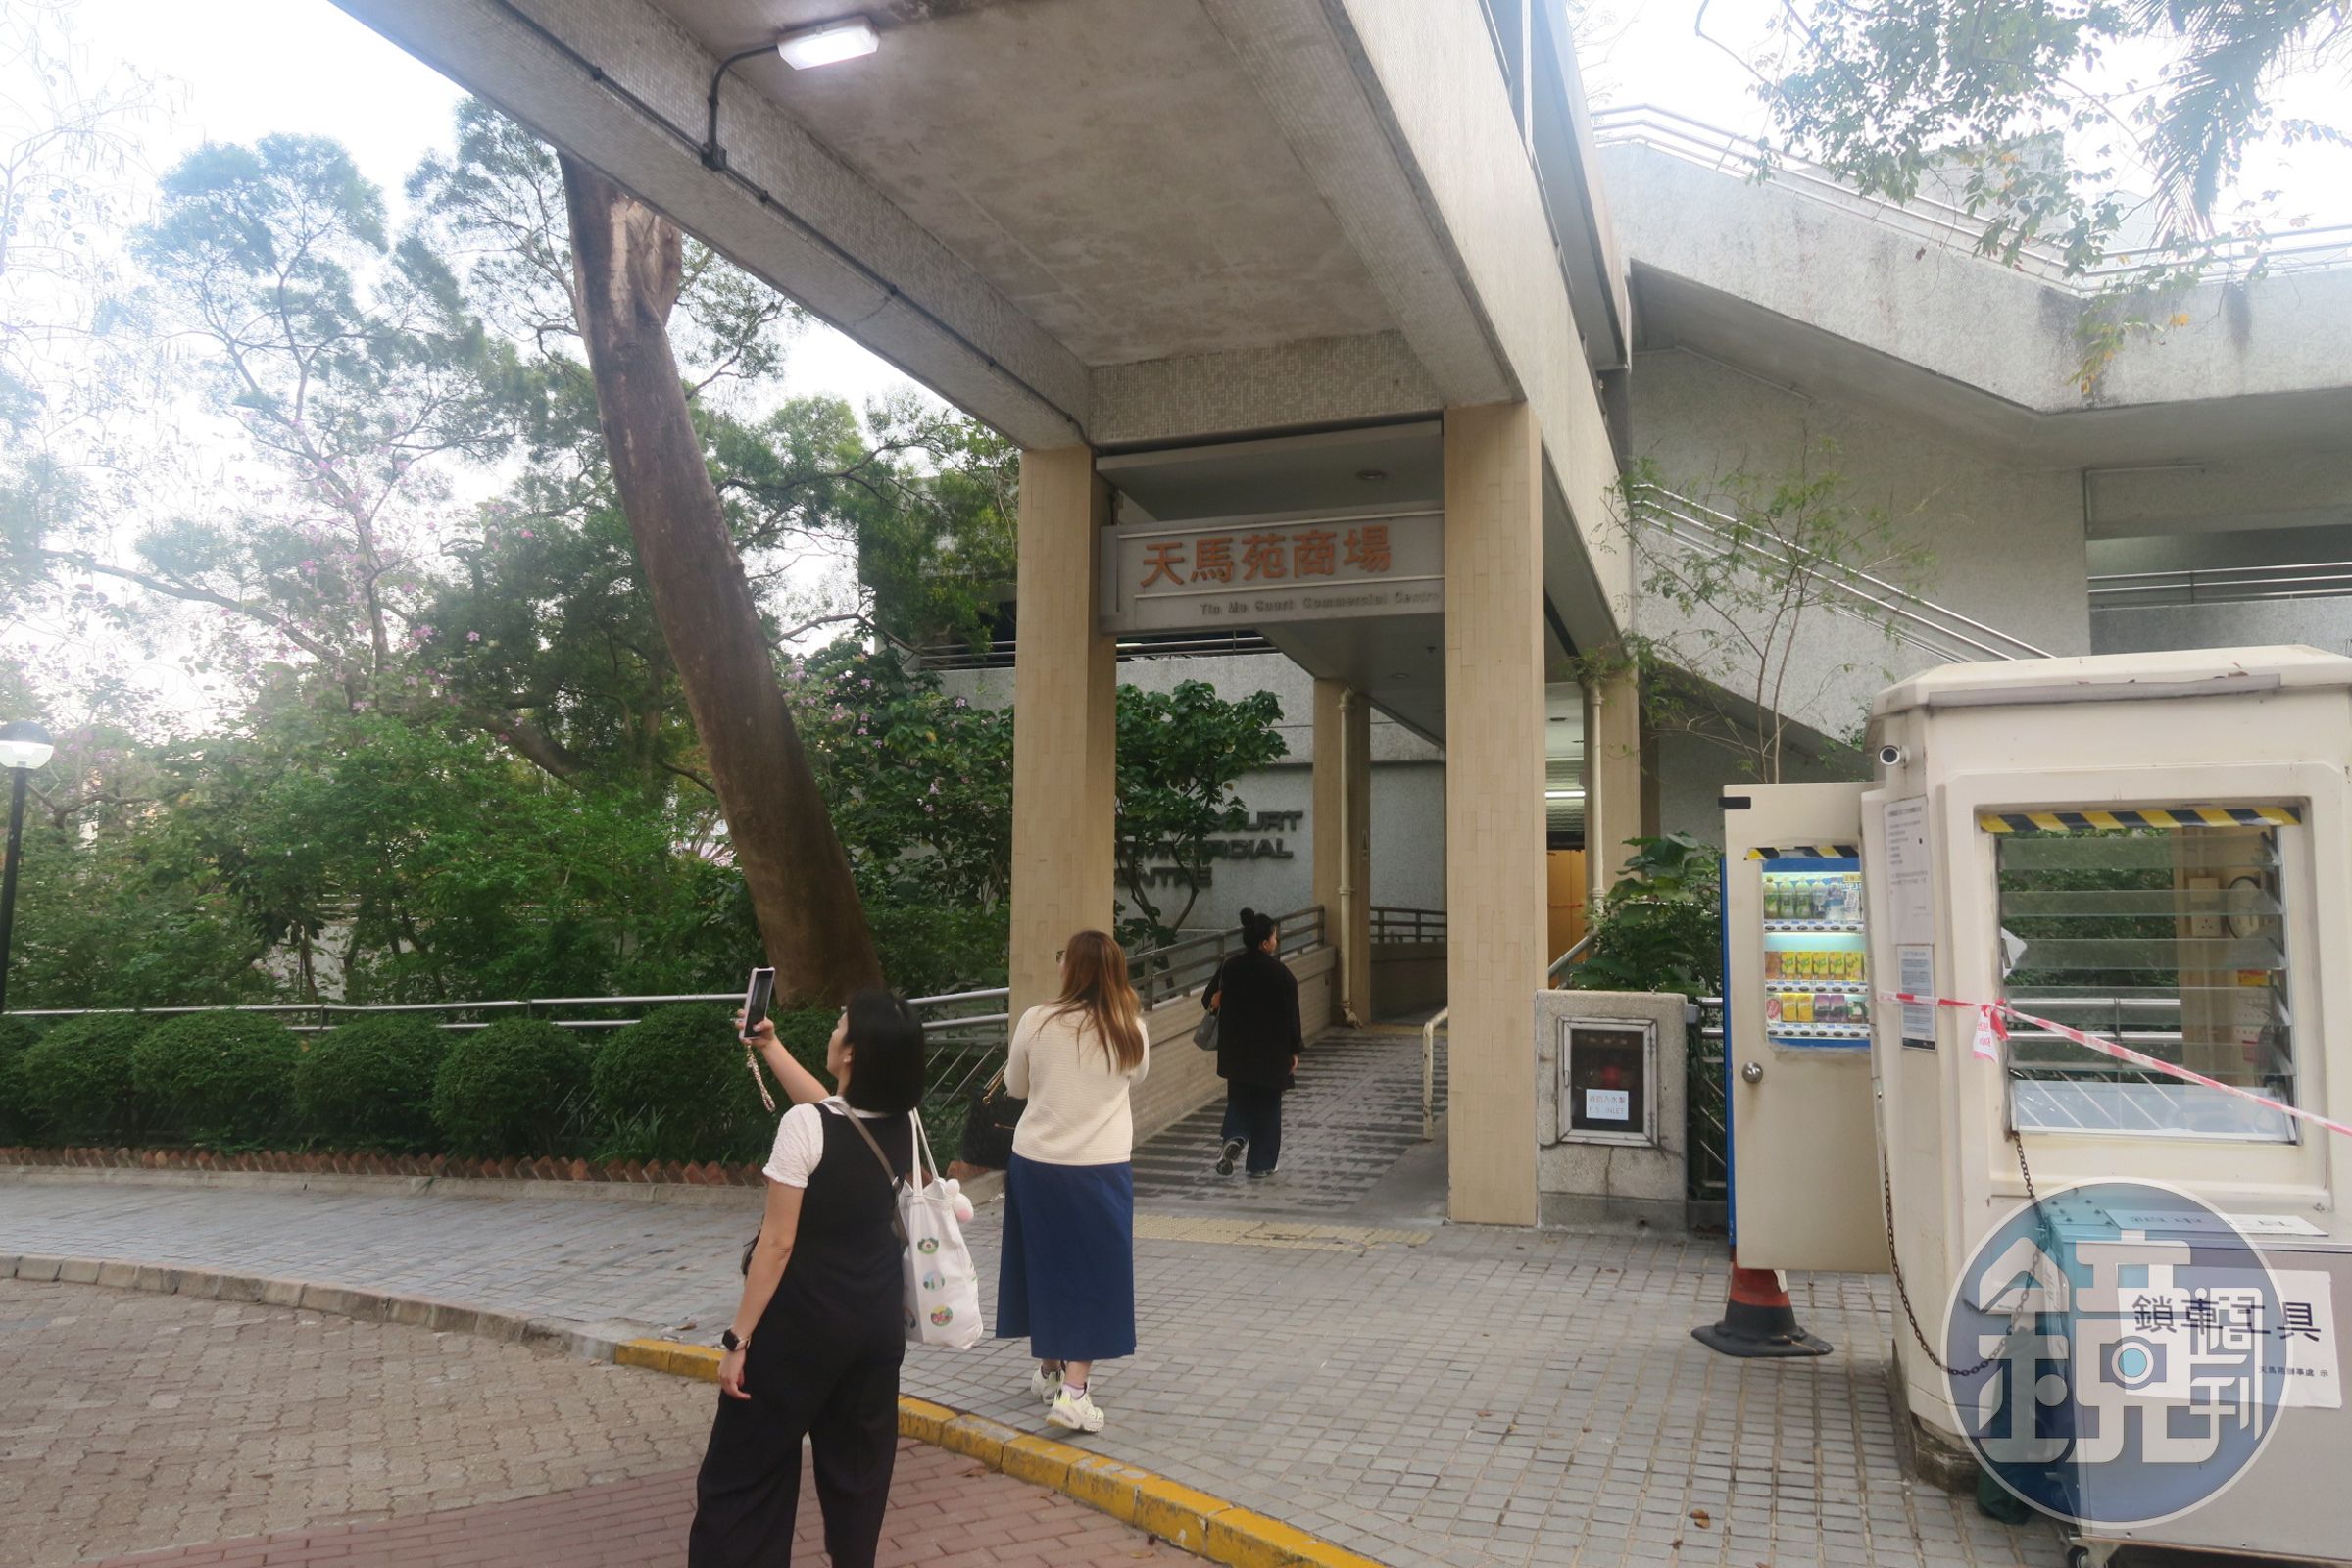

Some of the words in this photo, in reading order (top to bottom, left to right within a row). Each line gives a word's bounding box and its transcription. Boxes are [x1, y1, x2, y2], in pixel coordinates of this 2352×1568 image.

[1140, 524, 1392, 588] 天馬苑商場
[1200, 603, 1221, 615] Tin
[1228, 601, 1248, 613] Ma
[1254, 599, 1294, 612] Court
[1302, 591, 1388, 609] Commercial
[2132, 1294, 2322, 1343] 鎖車工具
